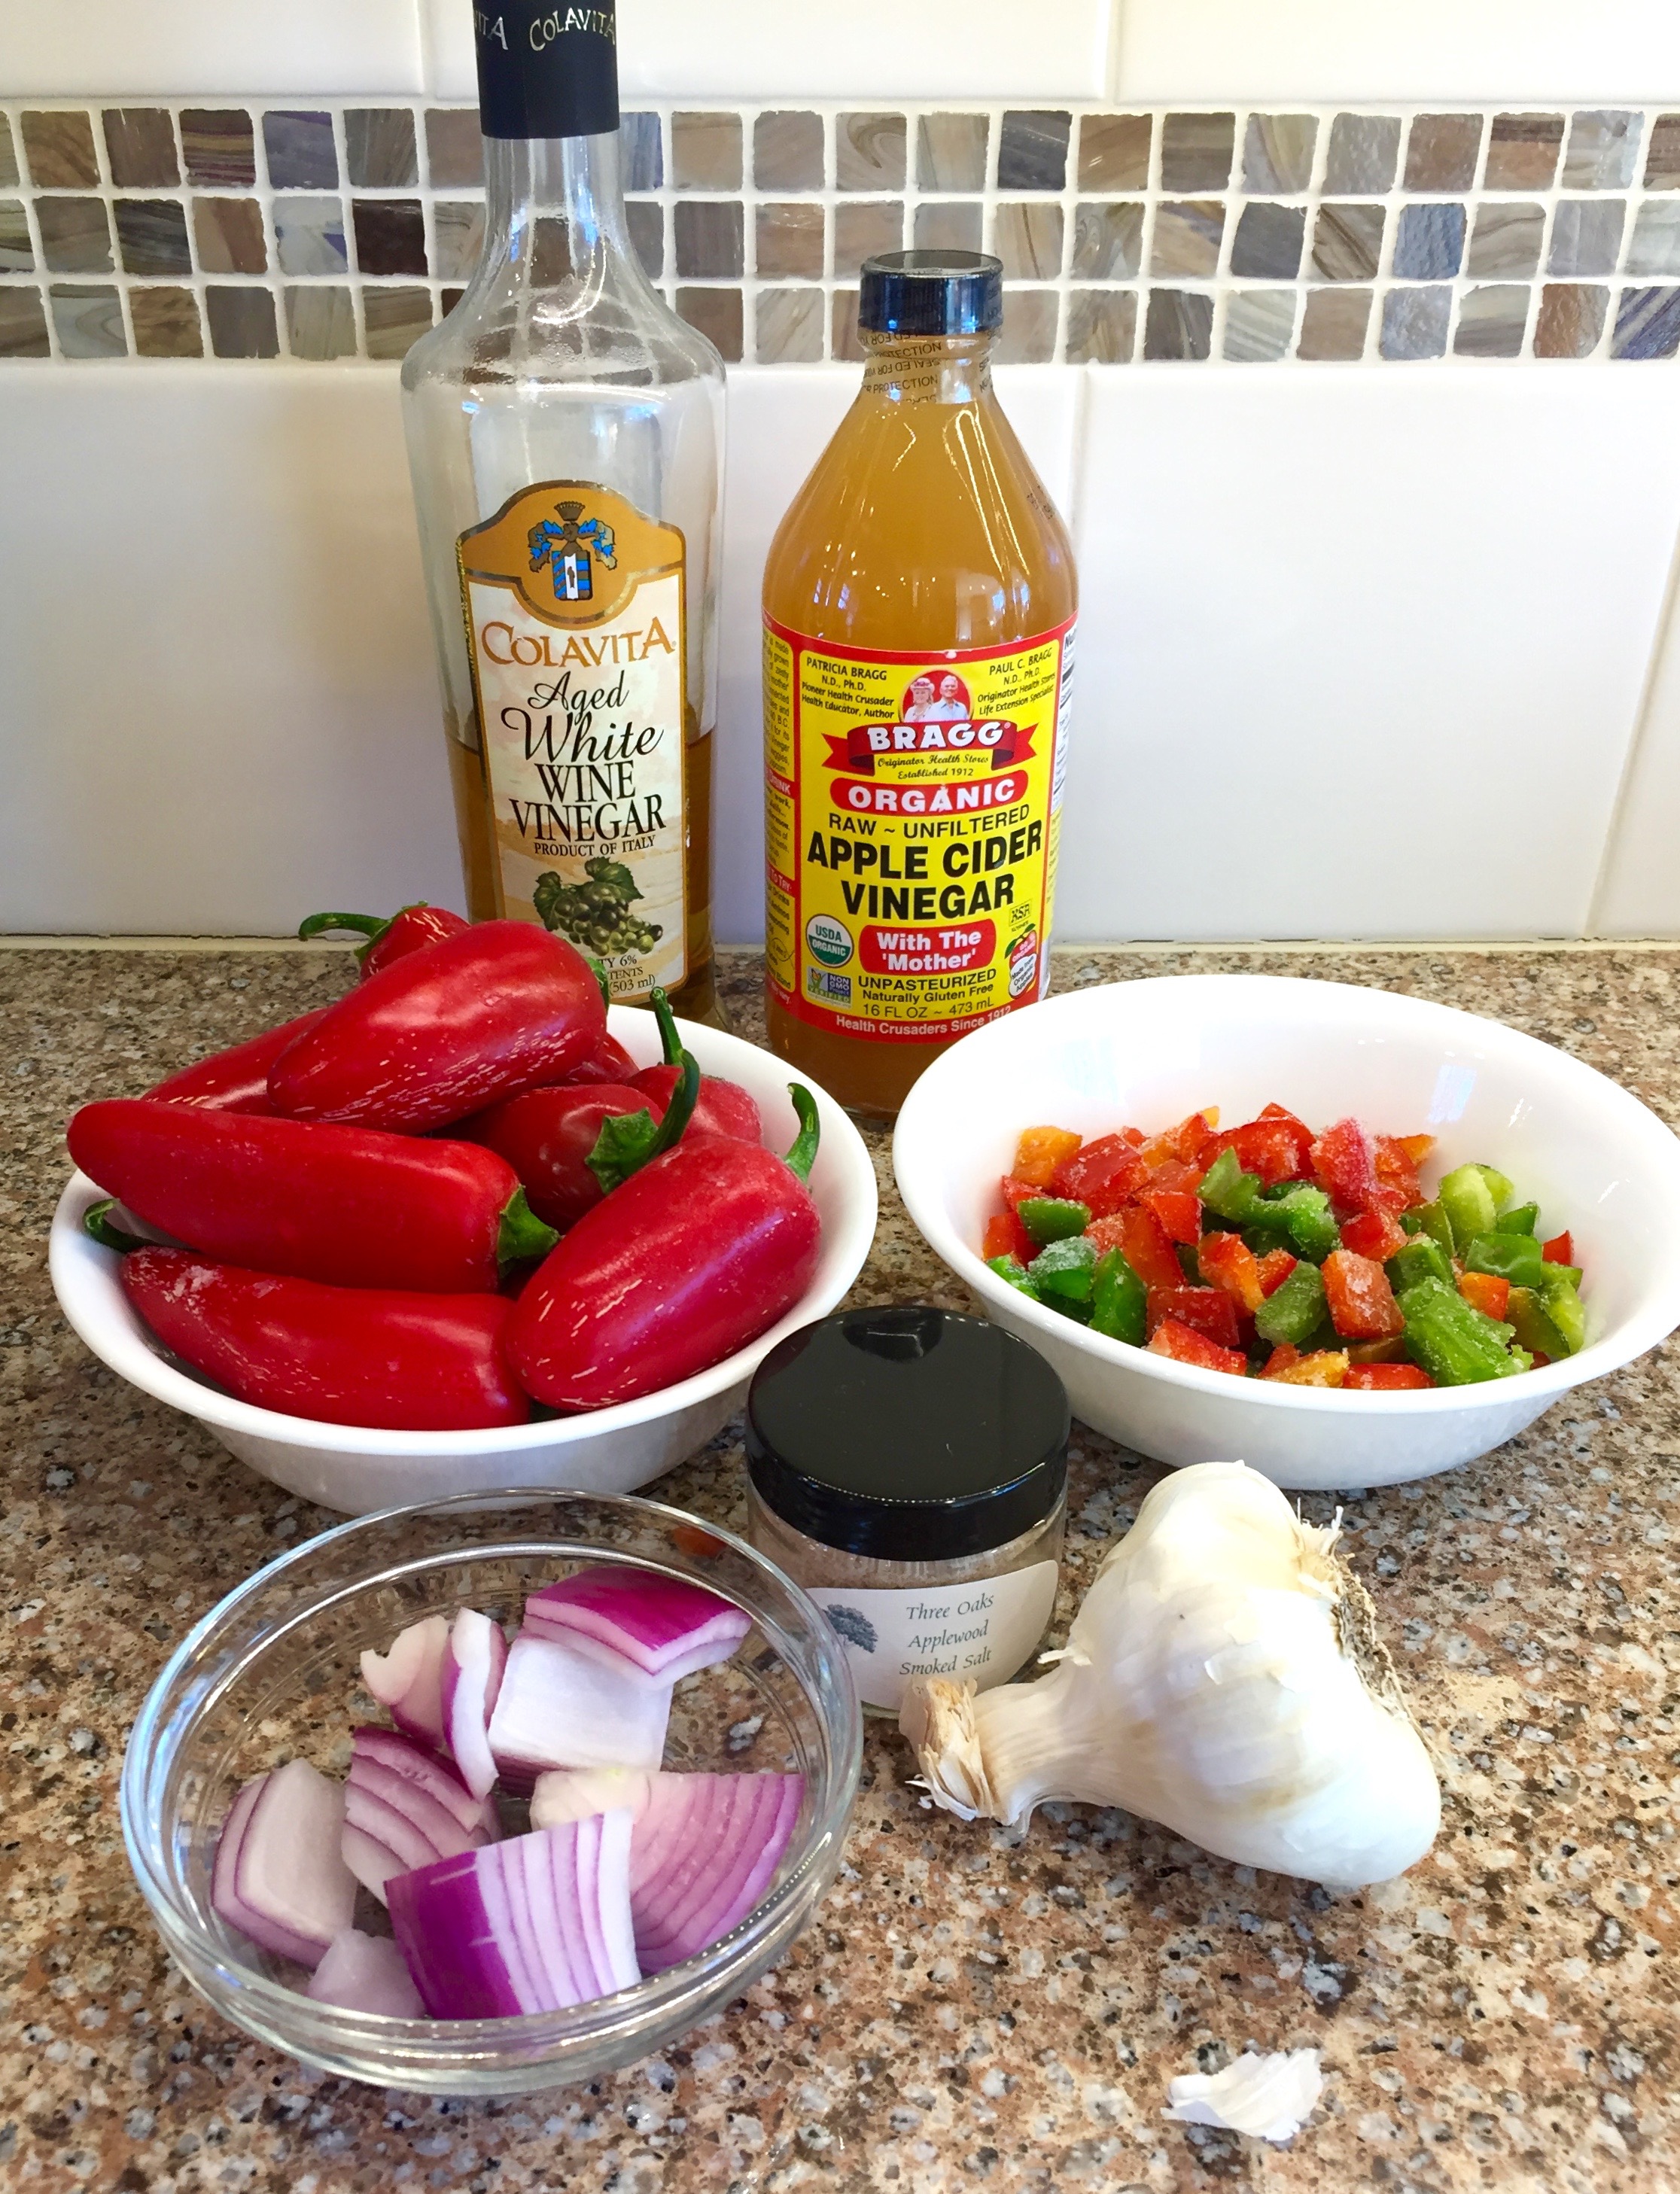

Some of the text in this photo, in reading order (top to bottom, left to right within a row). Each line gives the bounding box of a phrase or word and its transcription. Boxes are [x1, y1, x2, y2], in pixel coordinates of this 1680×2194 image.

[529, 8, 616, 51] COLAVITA
[873, 374, 938, 394] PROTECTION
[482, 616, 675, 668] COLAVITA
[806, 657, 887, 680] PATRICIA BRAGG
[989, 661, 1015, 676] PAUL
[1017, 659, 1026, 669] C.
[1028, 647, 1052, 665] BRAGG
[802, 682, 826, 697] Pioneer
[827, 687, 851, 701] Health
[853, 692, 894, 706] Crusader
[821, 674, 866, 692] N.D., Ph.D.
[978, 686, 1017, 703] Originator
[1018, 680, 1039, 696] Health
[527, 670, 629, 725] Aged
[802, 695, 823, 708] Health
[824, 699, 861, 717] Educator,
[864, 706, 894, 719] Author
[979, 703, 994, 716] Life
[995, 695, 1028, 712] Extension
[501, 707, 664, 762] White
[868, 722, 1003, 750] BRAGG
[878, 753, 989, 768] Originator Health Stores
[534, 760, 635, 803] WINE
[897, 767, 973, 781] Established 1912
[848, 778, 1015, 812] ORGANIC
[509, 794, 666, 842] VINEGAR
[829, 813, 877, 836] RAW
[903, 804, 1030, 838] UNFILTERED
[534, 835, 656, 857] PRODUCT OF ITALY
[807, 831, 928, 879] APPLE
[942, 820, 1042, 878] CIDER
[841, 873, 1014, 920] VINEGAR
[815, 924, 842, 942] USDA
[877, 930, 982, 951] With The
[812, 939, 847, 957] ORGANIC
[619, 954, 637, 966] 6%
[882, 950, 976, 971] 'Mother'
[607, 966, 644, 981] TENTS
[637, 974, 656, 990] ml)
[829, 975, 849, 984] NON
[858, 968, 997, 991] UNPASTEURIZED
[829, 981, 850, 990] GMO
[863, 989, 919, 1005] Naturally
[924, 990, 966, 1003] Gluten
[969, 983, 994, 997] Free
[863, 1004, 880, 1017] 16
[884, 1005, 902, 1018] FL
[905, 1006, 928, 1018] OZ
[948, 1003, 972, 1015] 473
[976, 997, 994, 1009] mL
[835, 1006, 1011, 1035] Health Crusaders Since 1912
[905, 1593, 994, 1620] Three Oaks
[908, 1619, 989, 1654] Applewood
[899, 1646, 992, 1675] Smoked Salt
